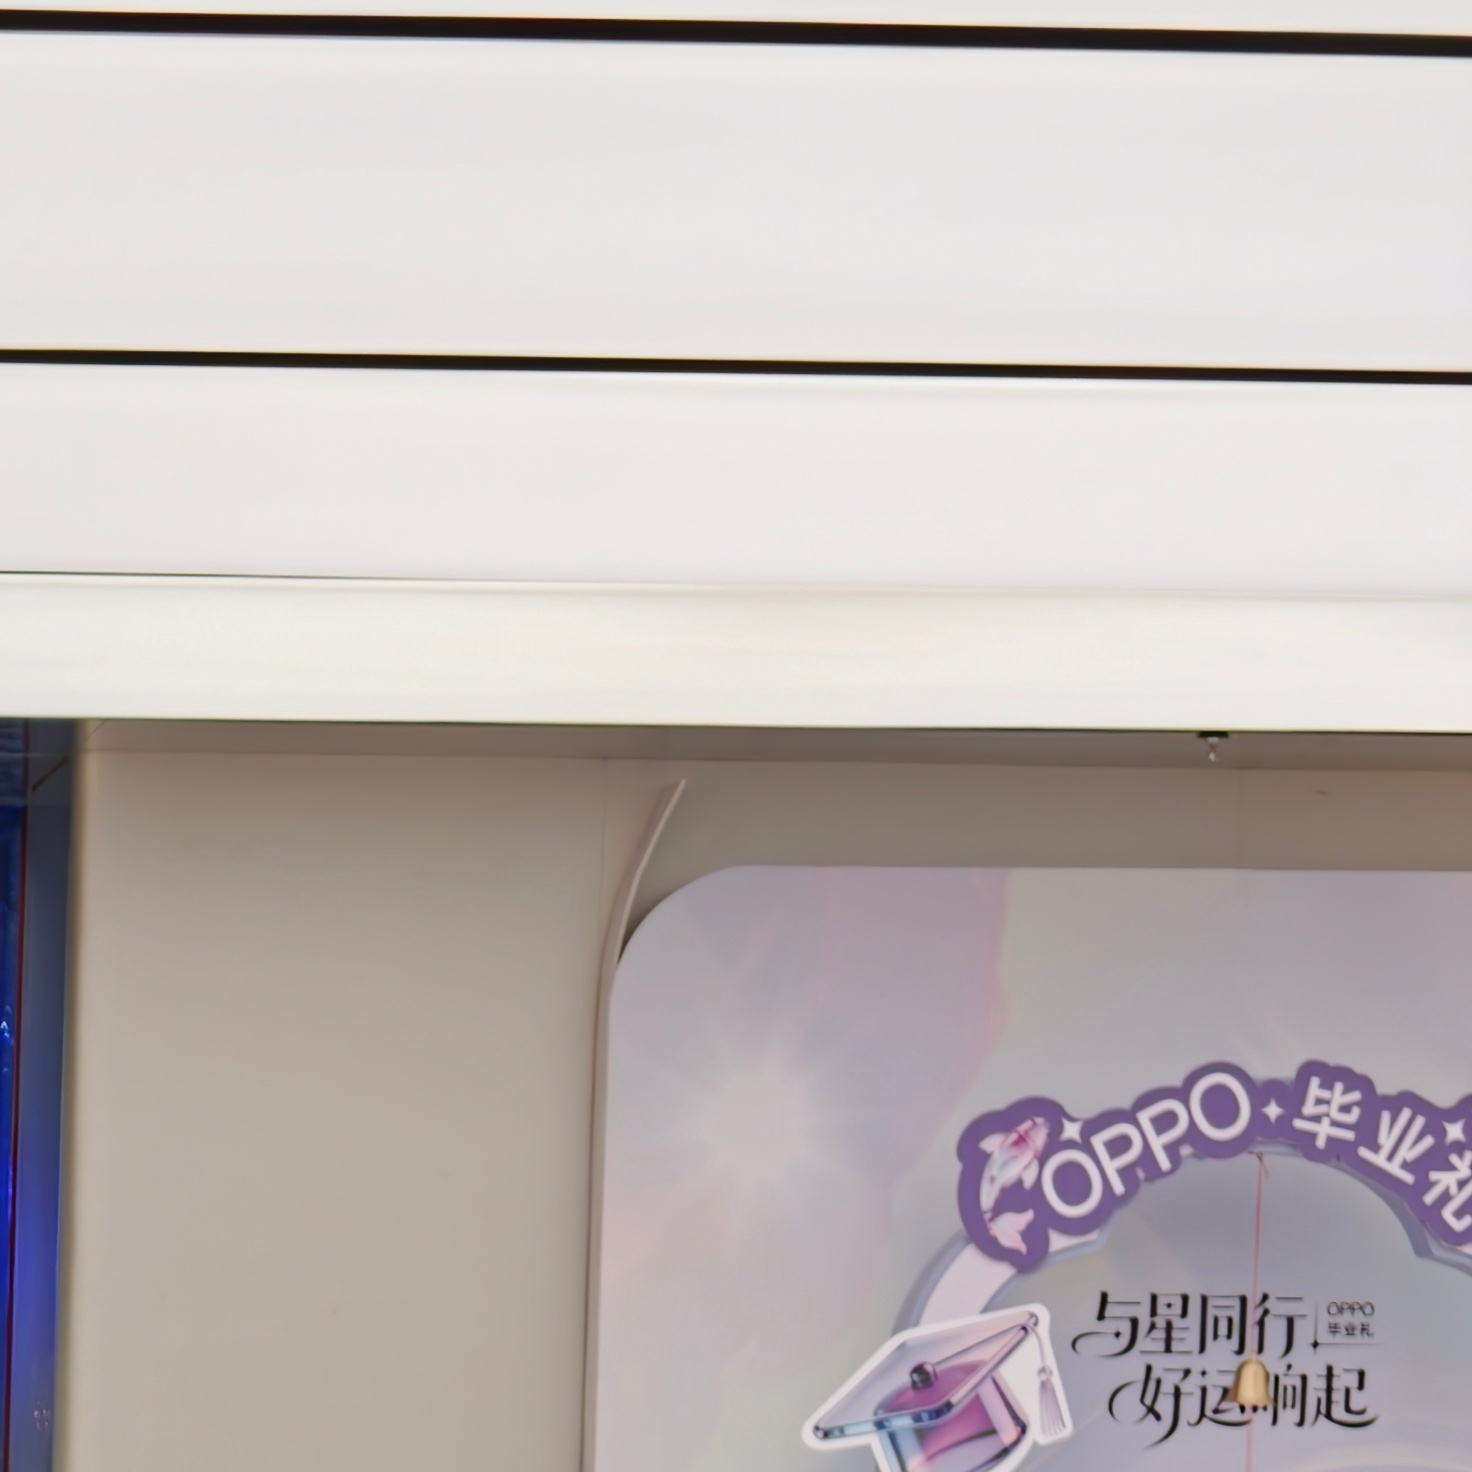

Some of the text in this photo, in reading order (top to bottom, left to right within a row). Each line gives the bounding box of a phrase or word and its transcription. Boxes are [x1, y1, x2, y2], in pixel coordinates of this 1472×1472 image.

[1040, 1071, 1252, 1218] OPPO
[1070, 1290, 1308, 1359] 与星同行
[1327, 1301, 1375, 1317] OPPO
